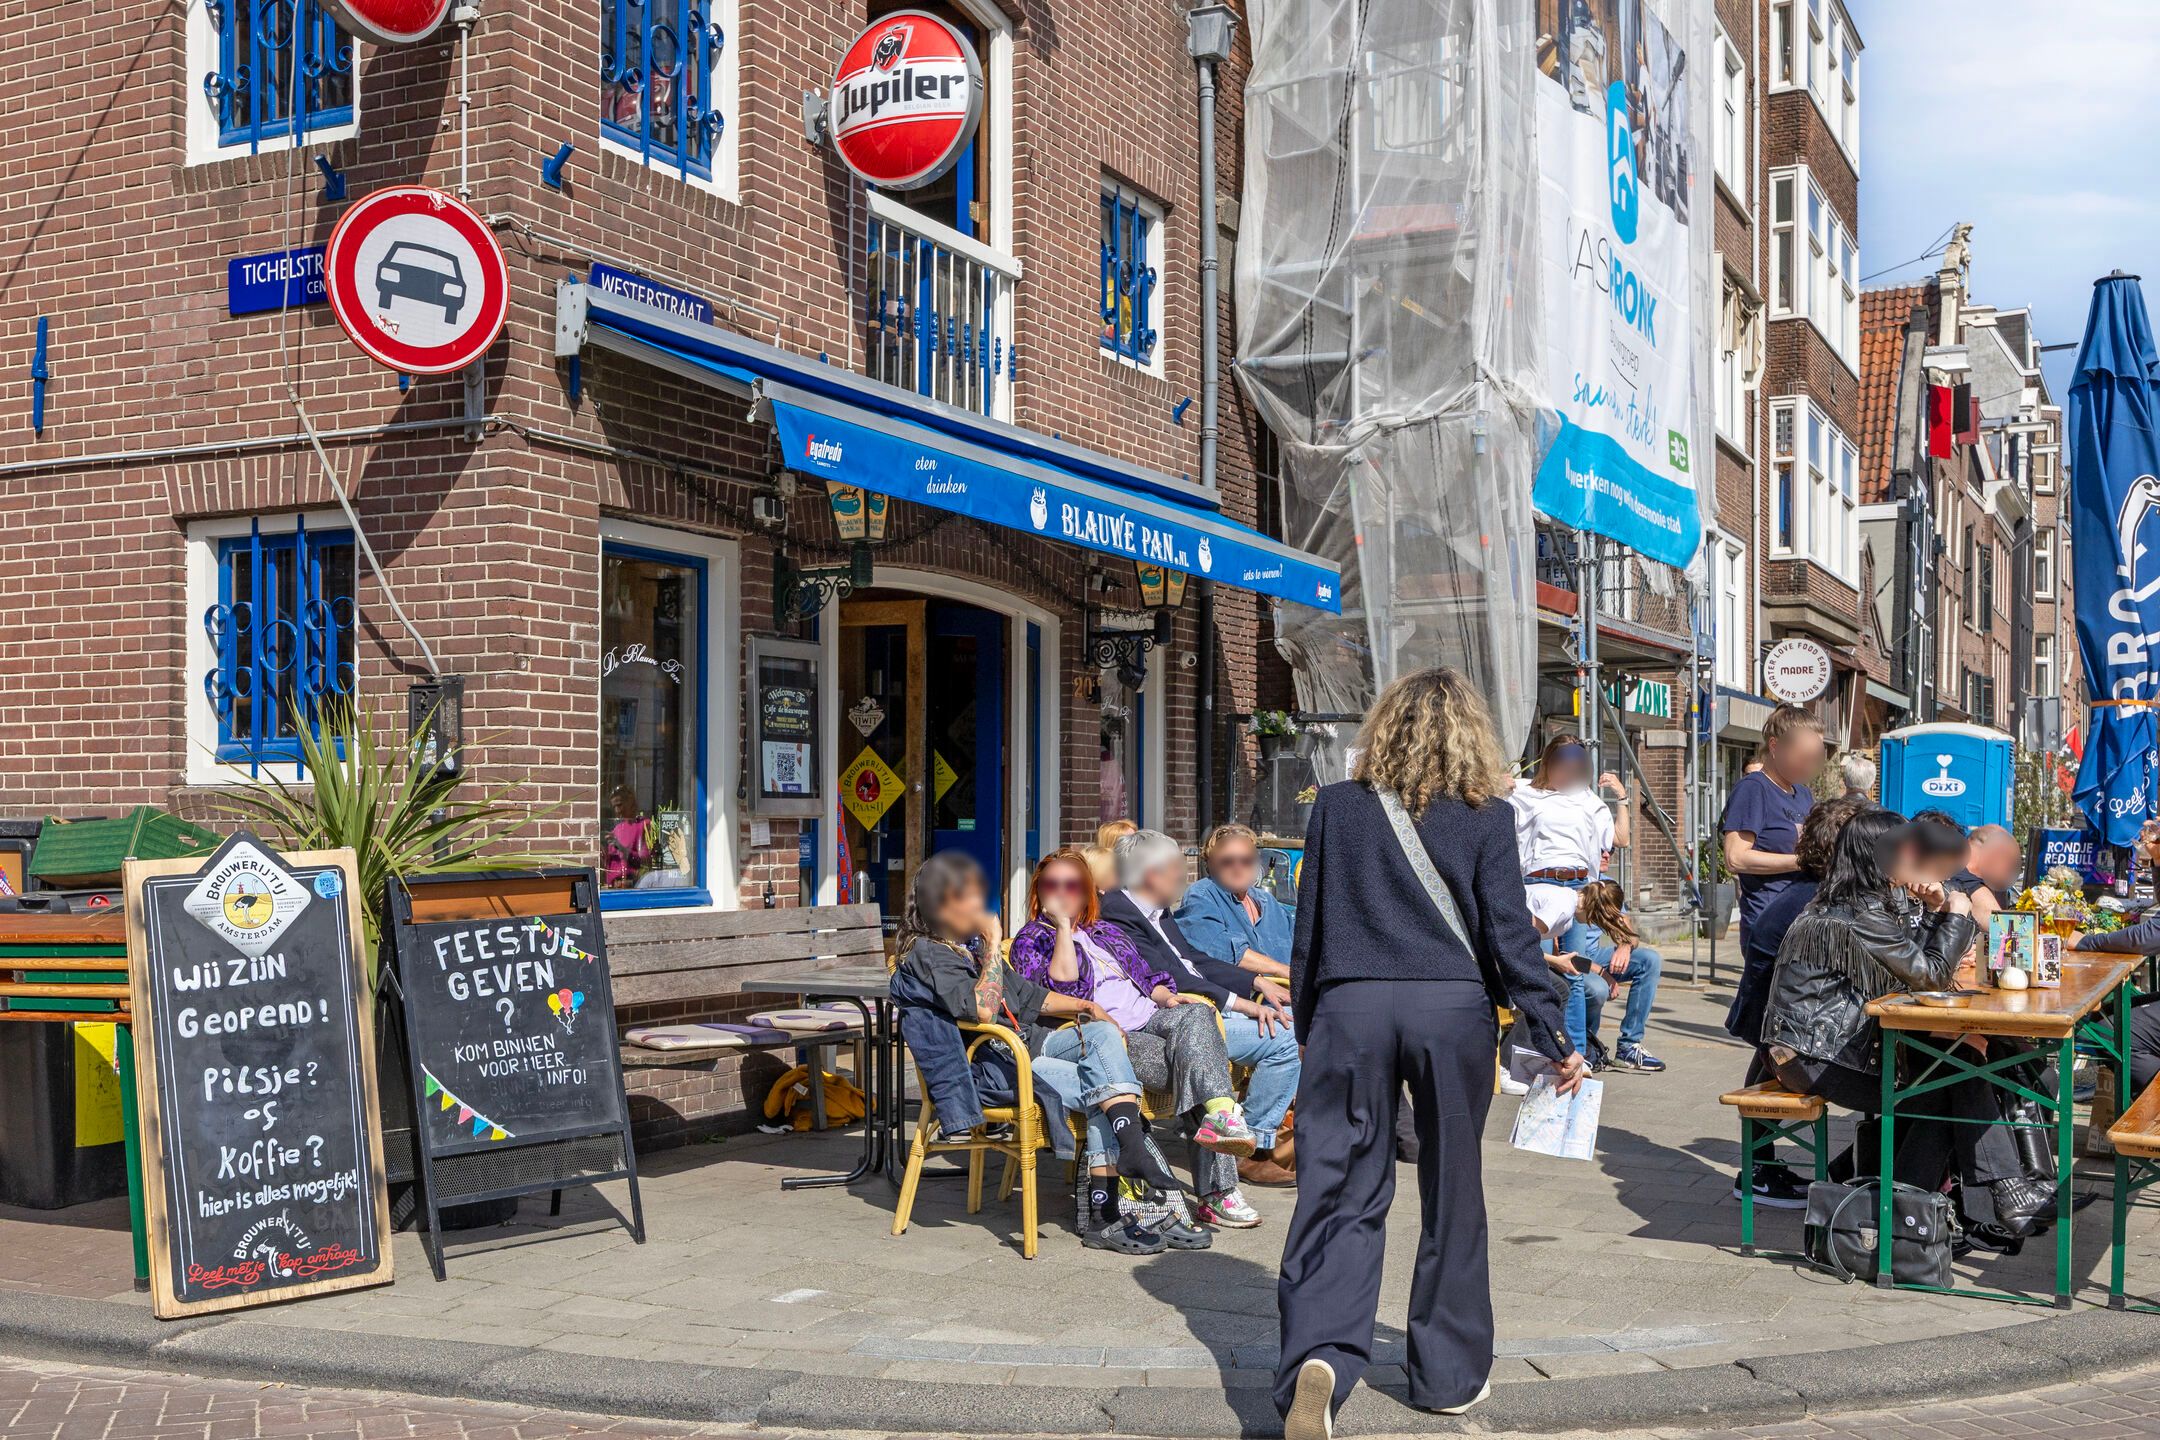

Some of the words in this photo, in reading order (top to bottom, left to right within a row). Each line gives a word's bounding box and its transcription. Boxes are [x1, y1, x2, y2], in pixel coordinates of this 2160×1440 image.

[837, 67, 965, 126] Jupiler
[601, 272, 704, 322] WESTERSTRAAT
[915, 455, 938, 471] eten
[926, 474, 969, 494] drinken
[1061, 503, 1137, 554] BLAUWE
[1774, 642, 1794, 659] LOVE
[1797, 642, 1819, 655] FOOD
[1767, 659, 1779, 689] WATER
[1780, 665, 1815, 676] MADRE
[1817, 656, 1827, 684] EARTH
[767, 687, 797, 700] Welcome
[1634, 679, 1668, 718] ZONE
[1779, 688, 1797, 699] SUN
[1800, 684, 1819, 698] SOIL
[661, 821, 679, 830] AREA
[2046, 841, 2094, 853] RONDJE
[2044, 853, 2066, 865] RED
[2067, 854, 2094, 865] BULL
[217, 917, 283, 940] AMSTERDAM
[433, 925, 582, 970] FEESTJE
[447, 958, 556, 1000] GEVEN
[495, 997, 515, 1034] ?
[454, 1042, 489, 1064] KOM
[493, 1033, 556, 1059] BINNEN
[479, 1057, 519, 1078] VOOR
[546, 1068, 588, 1085] INFO!
[243, 1100, 278, 1131] of
[199, 1190, 234, 1218] hier
[235, 1190, 253, 1210] is
[254, 1183, 291, 1206] alles
[292, 1168, 358, 1204] mogelijk!
